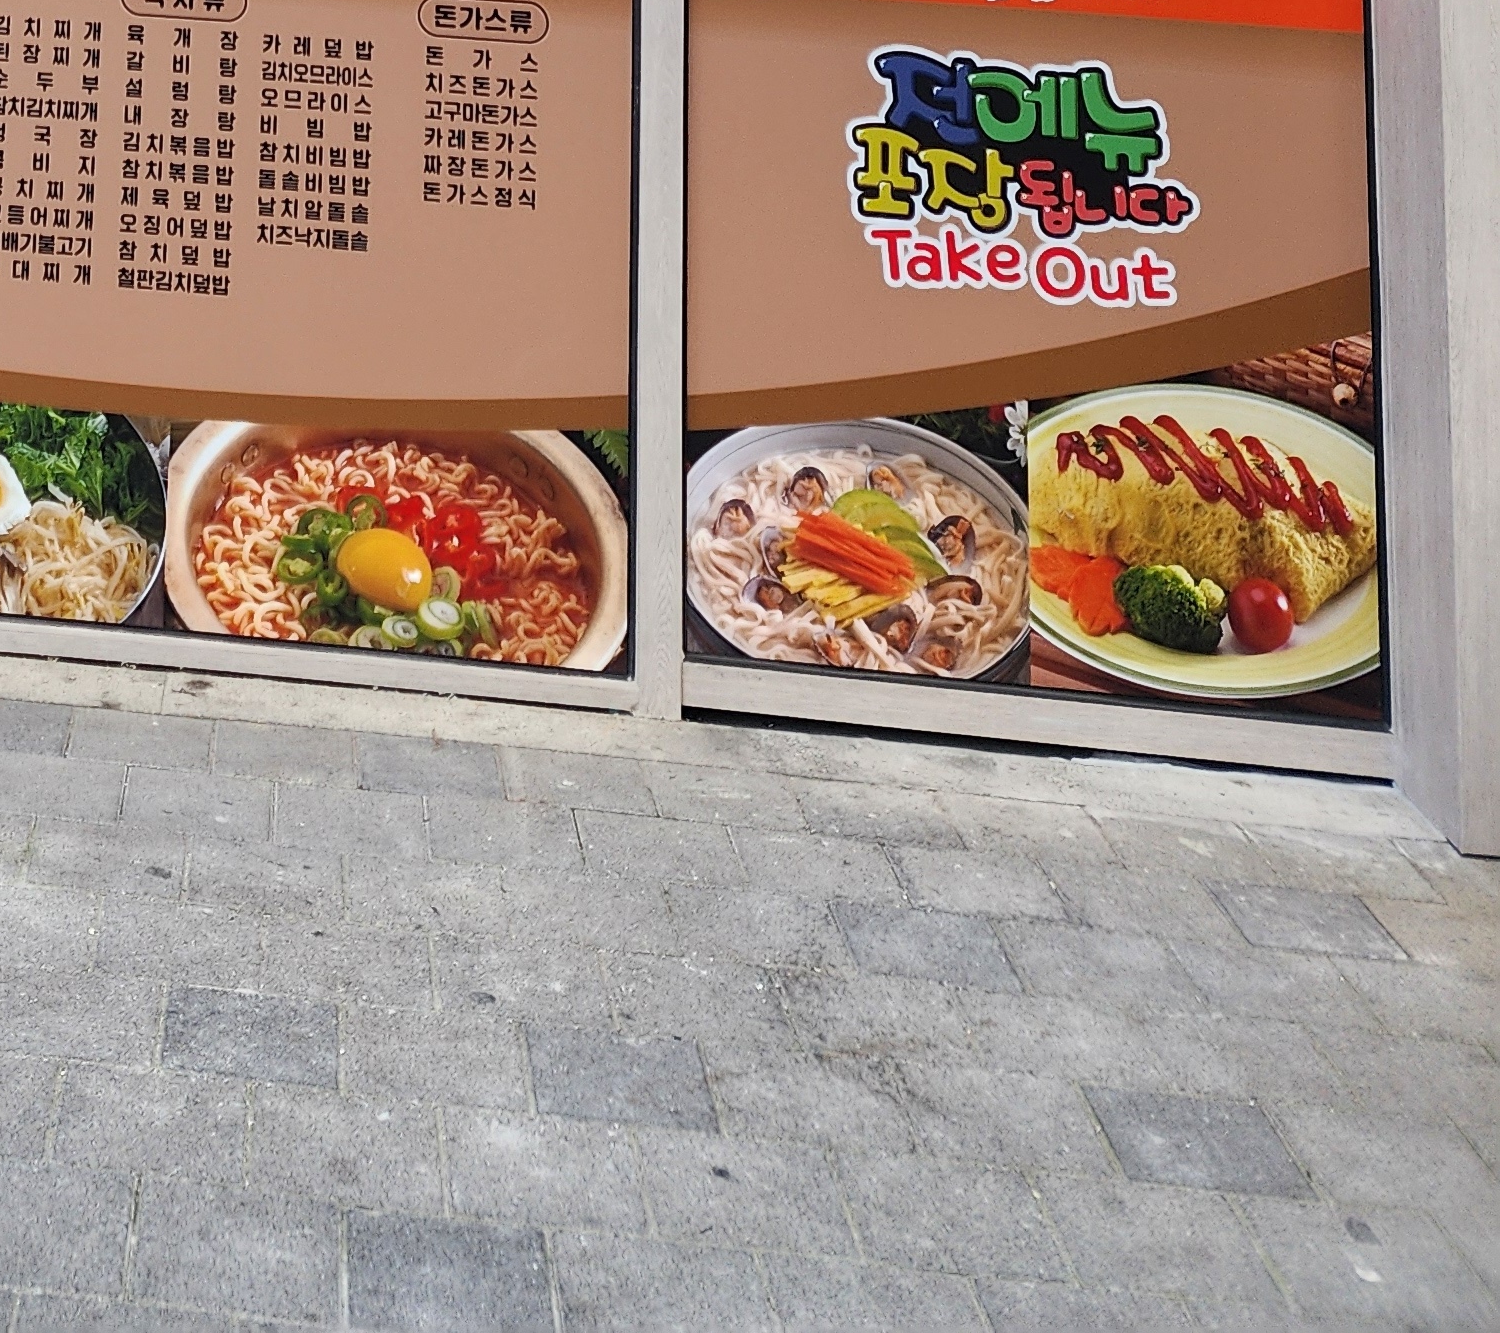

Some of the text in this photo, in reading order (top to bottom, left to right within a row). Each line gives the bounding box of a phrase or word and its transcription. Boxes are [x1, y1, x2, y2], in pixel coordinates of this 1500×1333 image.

[435, 5, 532, 34] 돈가스류
[127, 25, 239, 51] 육개장
[263, 34, 374, 61] 카레덮밥
[127, 51, 238, 77] 갈비탕
[426, 46, 538, 73] 돈가스
[262, 61, 373, 88] 김치오므라이스
[425, 72, 538, 100] 치즈돈가스
[125, 78, 237, 104] 설렁탕
[261, 88, 371, 115] 오므라이스
[124, 105, 236, 131] 내장탕
[425, 100, 537, 127] 고구마돈가스
[260, 115, 372, 142] 비빔밥
[424, 127, 536, 155] 카레돈가스
[123, 132, 235, 159] 김치볶음밥
[260, 141, 371, 169] 참치비빔밥
[122, 158, 234, 186] 참치볶음밥
[424, 155, 536, 182] 짜장돈가스
[853, 125, 1193, 238] 포장됩니다
[121, 186, 233, 213] 제육덮밥
[423, 182, 535, 210] 돈가스정식
[119, 214, 232, 241] 오징어덮밥
[119, 240, 232, 268] 참치덮밥
[871, 230, 1170, 301] Take Out
[118, 267, 230, 296] 철판김치덮밥
